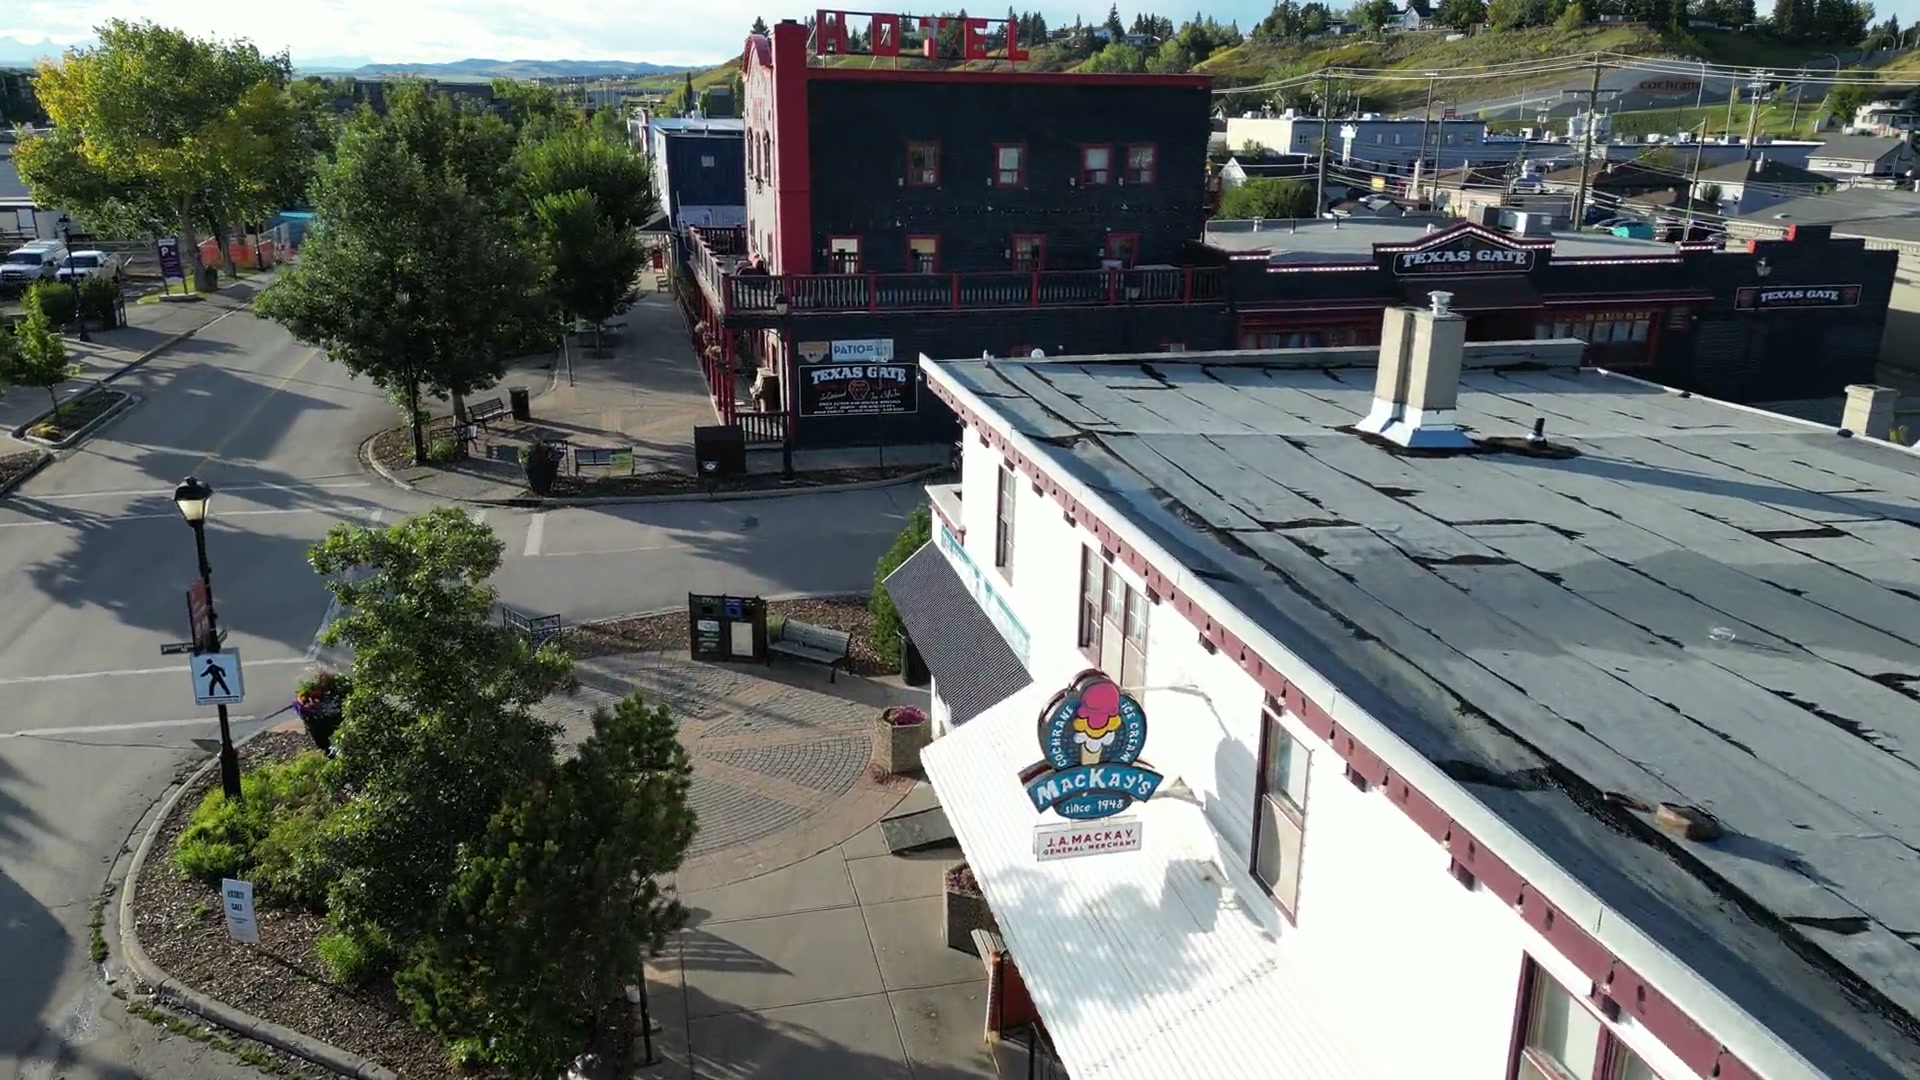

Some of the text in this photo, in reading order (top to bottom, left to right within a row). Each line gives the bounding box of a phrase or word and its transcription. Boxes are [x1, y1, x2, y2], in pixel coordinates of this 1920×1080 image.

[817, 9, 1029, 61] HOTEL
[1402, 250, 1471, 268] TEXAS
[1476, 250, 1527, 264] GATE
[1761, 290, 1804, 302] TEXAS
[1806, 290, 1839, 301] GATE
[833, 344, 865, 355] PATIO
[811, 366, 906, 384] TEXAS GATE
[1051, 705, 1074, 767] COCHRANE
[1120, 722, 1140, 762] CREAM
[1064, 799, 1124, 814] since 1948
[1043, 840, 1136, 856] GENERAL MERCHANT
